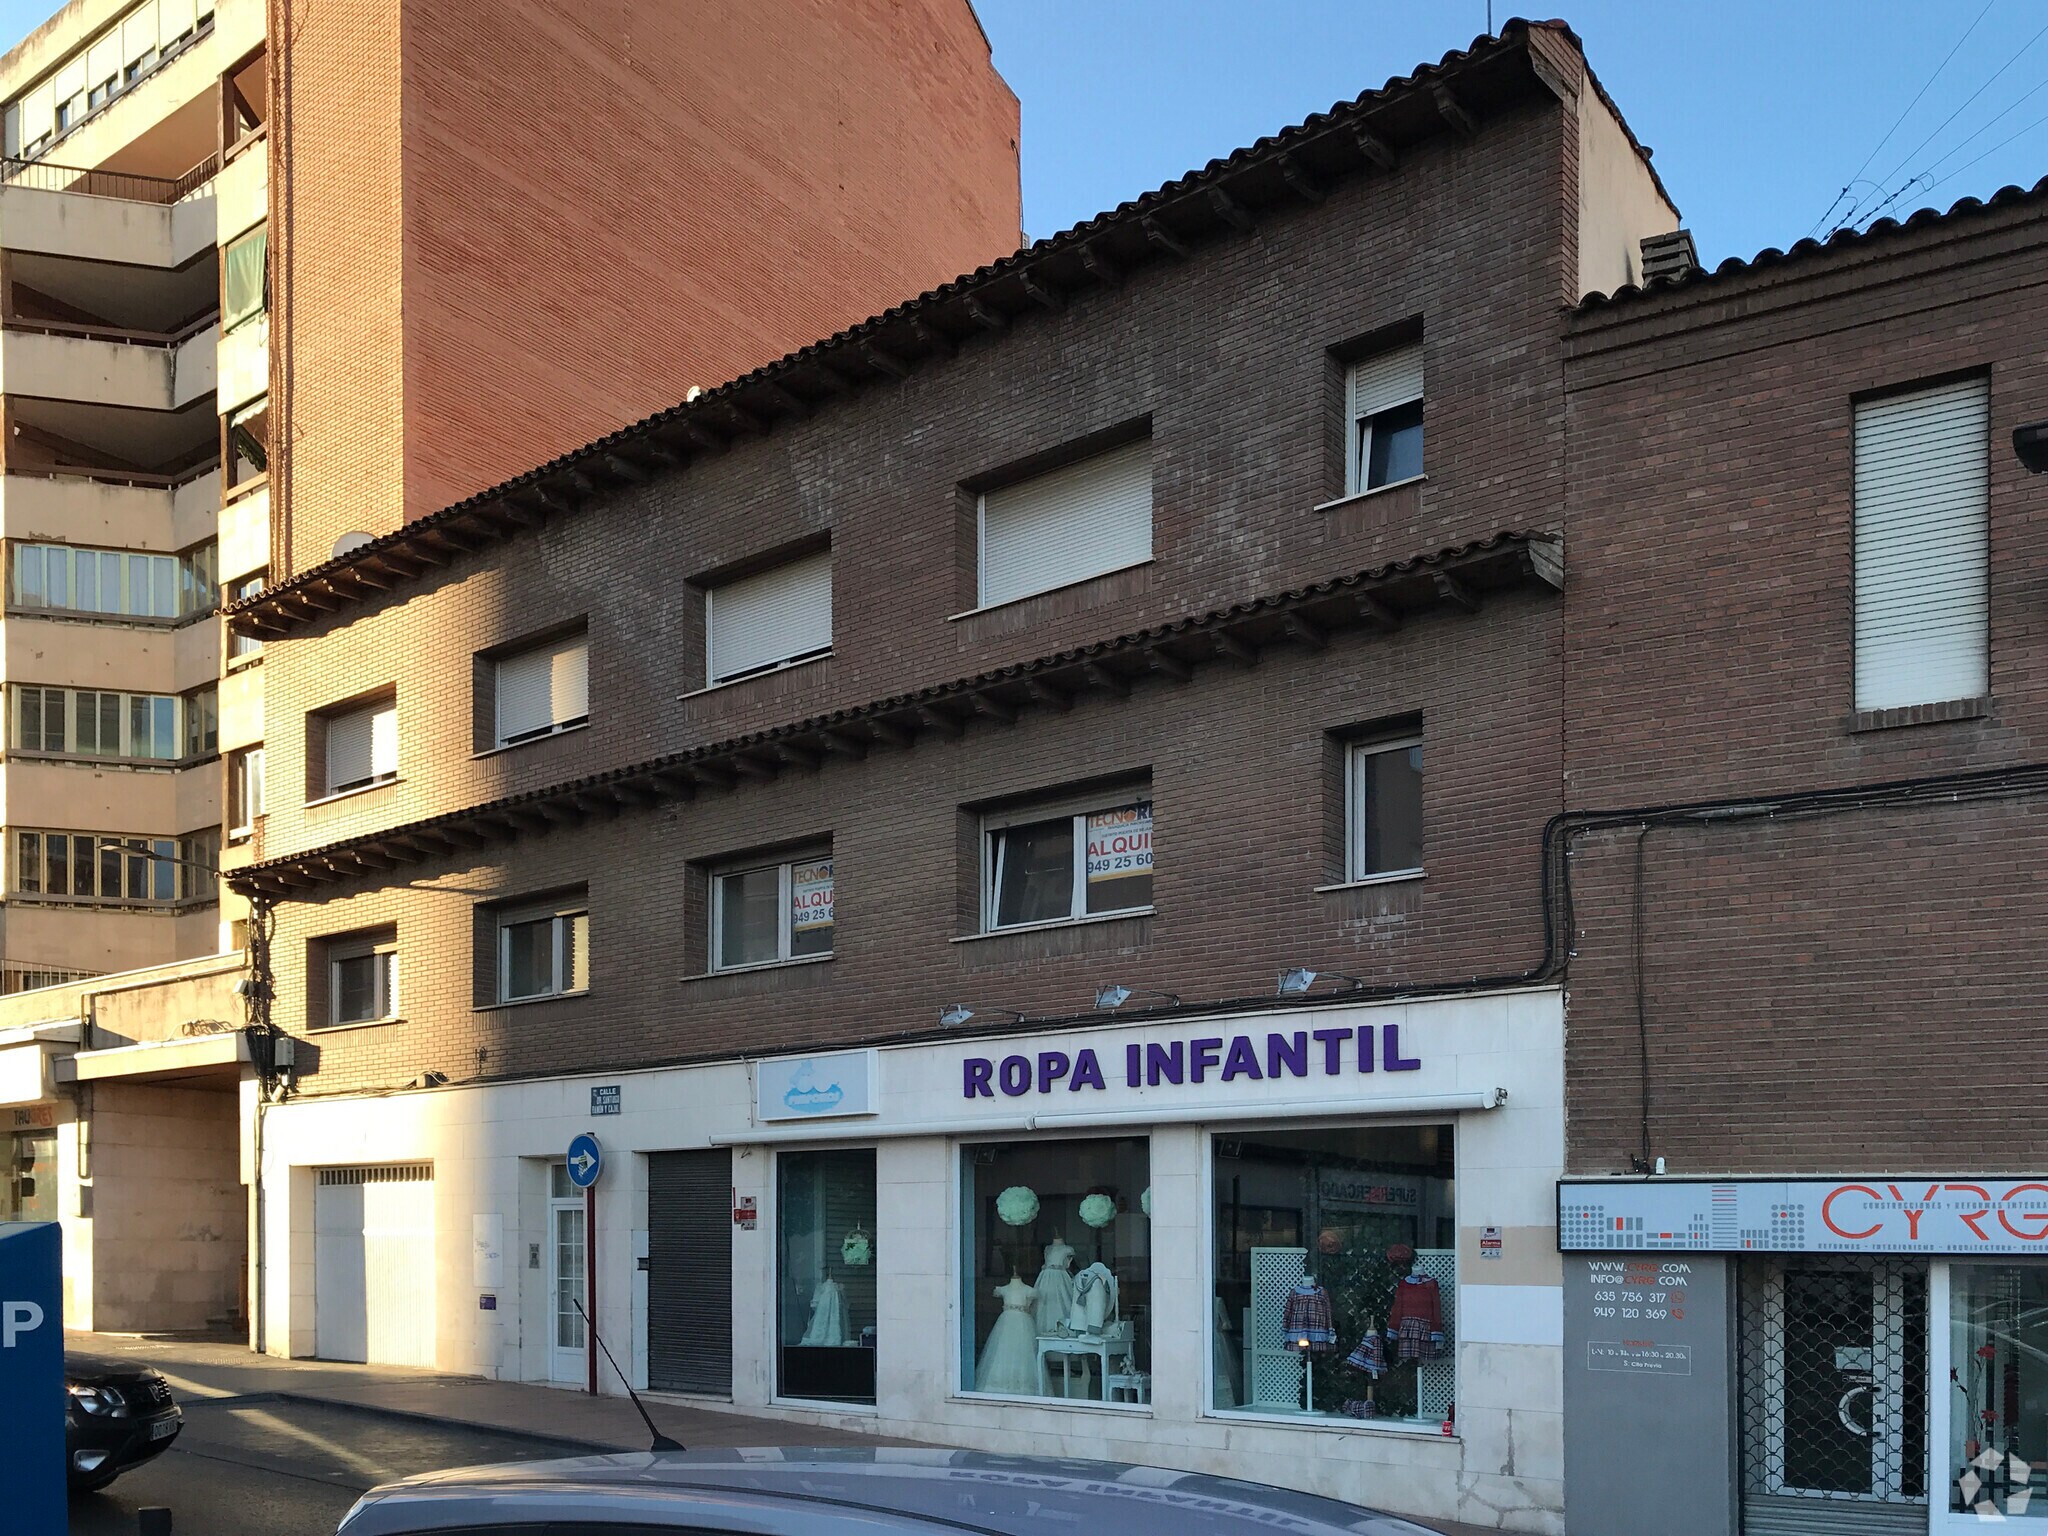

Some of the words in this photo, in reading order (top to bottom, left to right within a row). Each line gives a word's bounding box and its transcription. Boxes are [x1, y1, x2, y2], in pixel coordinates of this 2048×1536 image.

[1088, 832, 1153, 857] ALQUI
[1088, 860, 1110, 874] 949
[1114, 856, 1132, 868] 25
[1136, 851, 1153, 866] 60
[812, 908, 825, 921] 25
[963, 1048, 1106, 1099] ROPA
[1126, 1024, 1421, 1088] INFANTIL
[600, 1088, 616, 1096] CALLE
[1822, 1183, 2048, 1241] CYRG
[1863, 1202, 1943, 1210] CONSTRUCCIONES
[1872, 1243, 1935, 1251] INTERIORISMO
[1594, 1291, 1616, 1301] 635
[1621, 1291, 1643, 1302] 756
[1648, 1292, 1666, 1303] 317
[1593, 1306, 1616, 1317] 949
[1621, 1307, 1640, 1318] 120
[1645, 1308, 1667, 1320] 369
[2, 1301, 44, 1348] P
